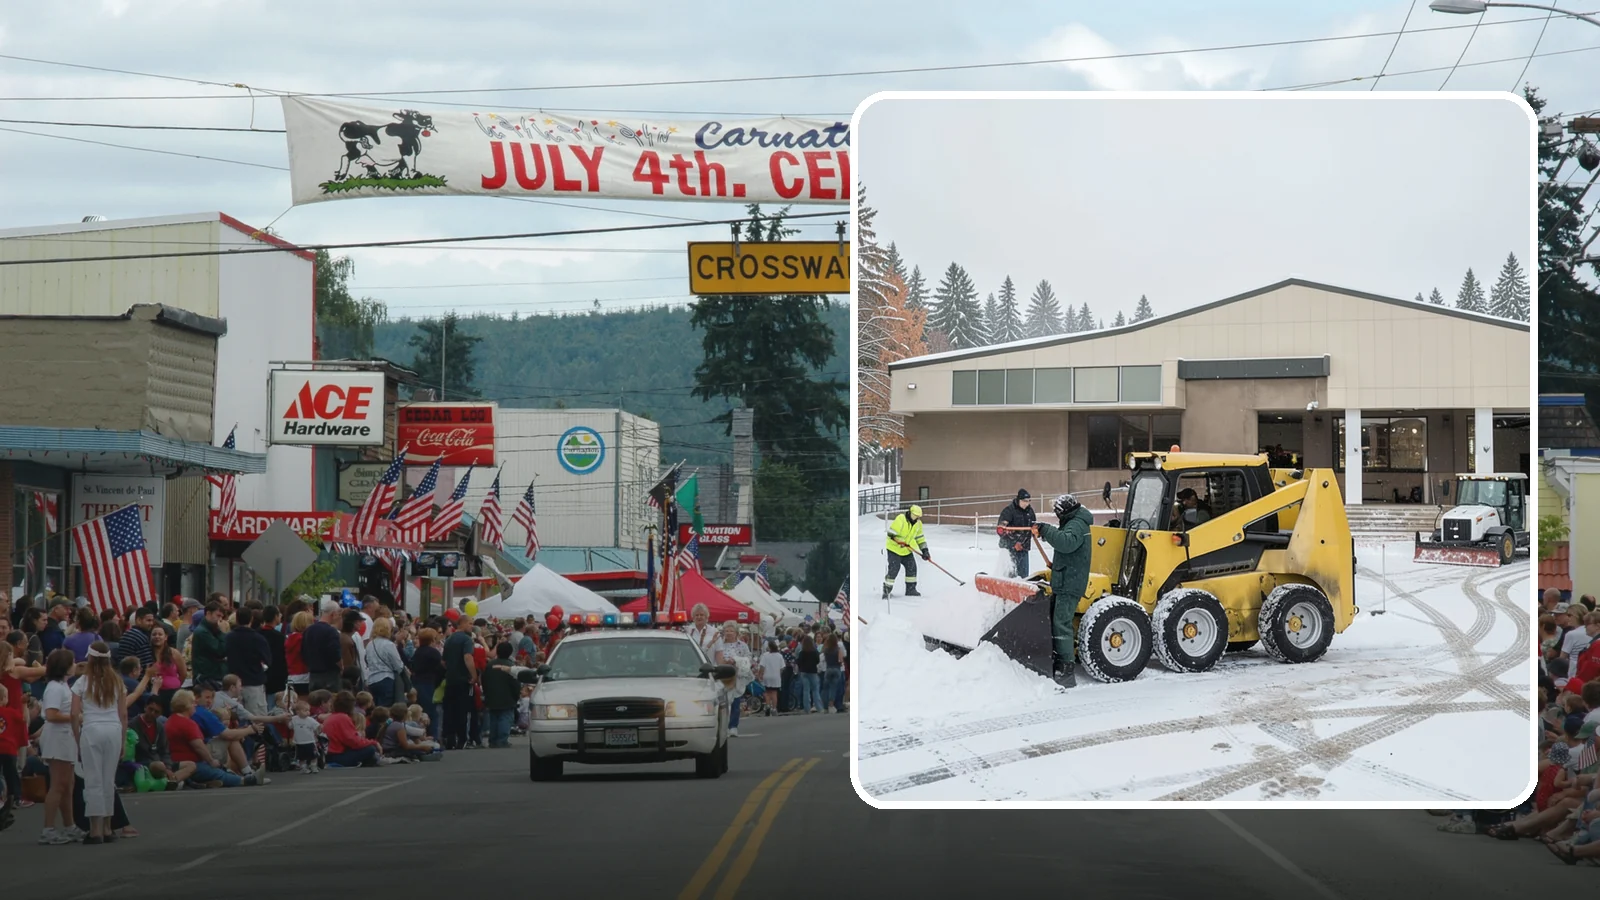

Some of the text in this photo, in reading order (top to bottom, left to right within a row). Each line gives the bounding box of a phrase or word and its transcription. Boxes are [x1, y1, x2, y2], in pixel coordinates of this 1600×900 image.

[695, 121, 850, 149] Carnat
[481, 141, 604, 192] JULY
[632, 150, 746, 198] 4th.
[696, 253, 850, 280] CROSSWA
[283, 380, 373, 419] ACE
[406, 409, 452, 421] CEDAR
[283, 421, 371, 436] Hardware
[416, 428, 477, 446] Coca-Cola
[354, 467, 385, 480] Simpl
[83, 485, 155, 495] St. Vincent de Paul
[688, 526, 741, 535] CRNATION
[699, 535, 730, 543] GLASS
